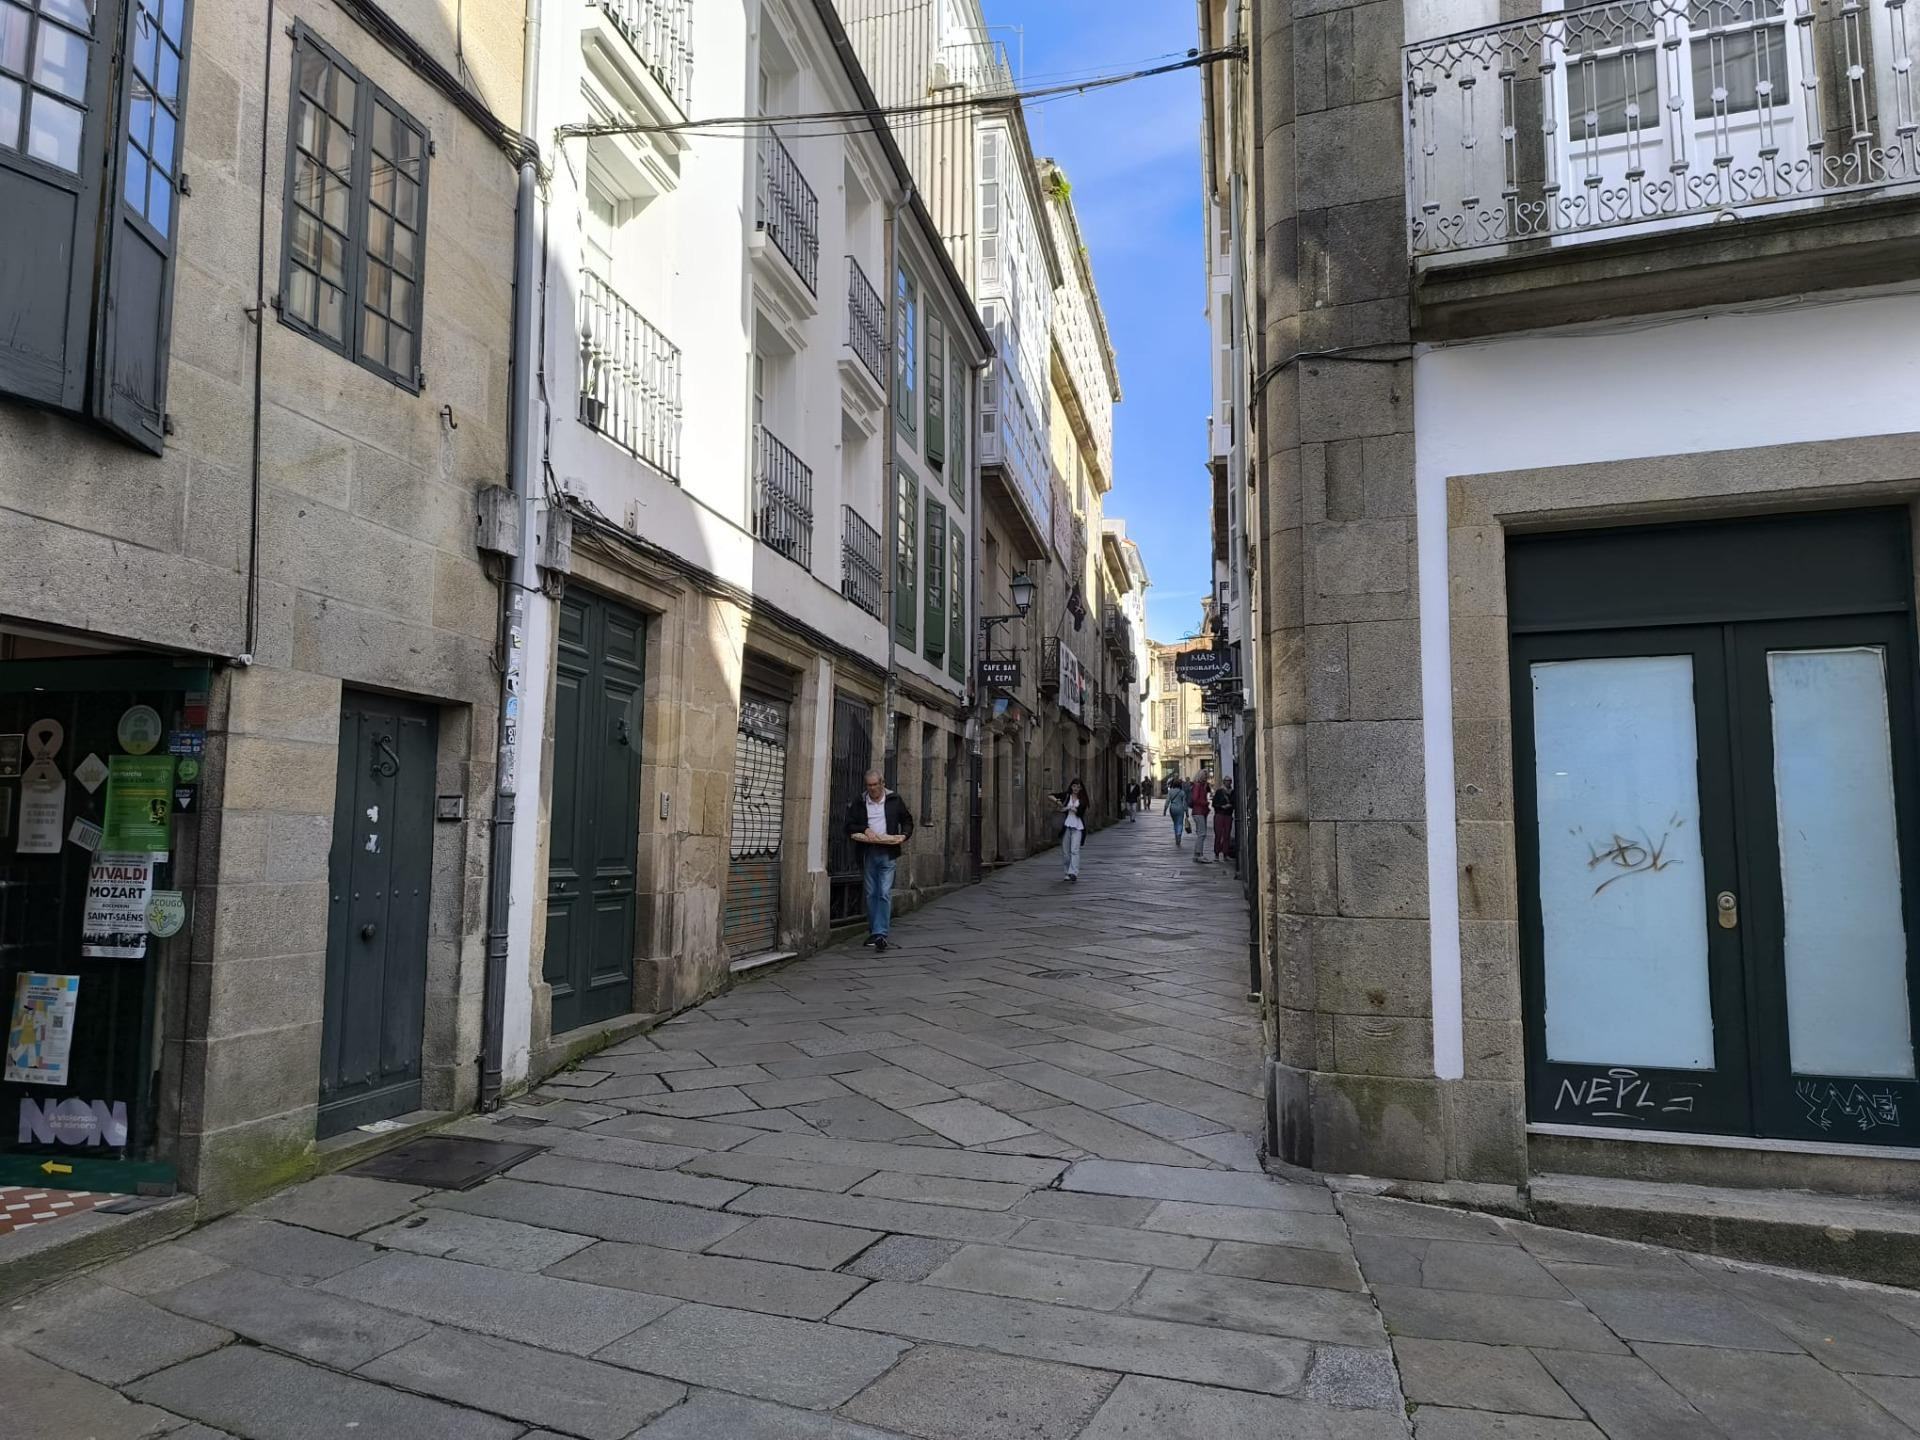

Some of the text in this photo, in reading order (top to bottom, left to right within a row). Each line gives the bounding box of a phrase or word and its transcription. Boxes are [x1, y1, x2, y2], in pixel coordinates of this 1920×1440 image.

[90, 866, 148, 881] VIVALDI
[89, 886, 146, 899] MOZART
[87, 911, 144, 922] SAINT-SAËNS
[18, 1098, 128, 1147] NON
